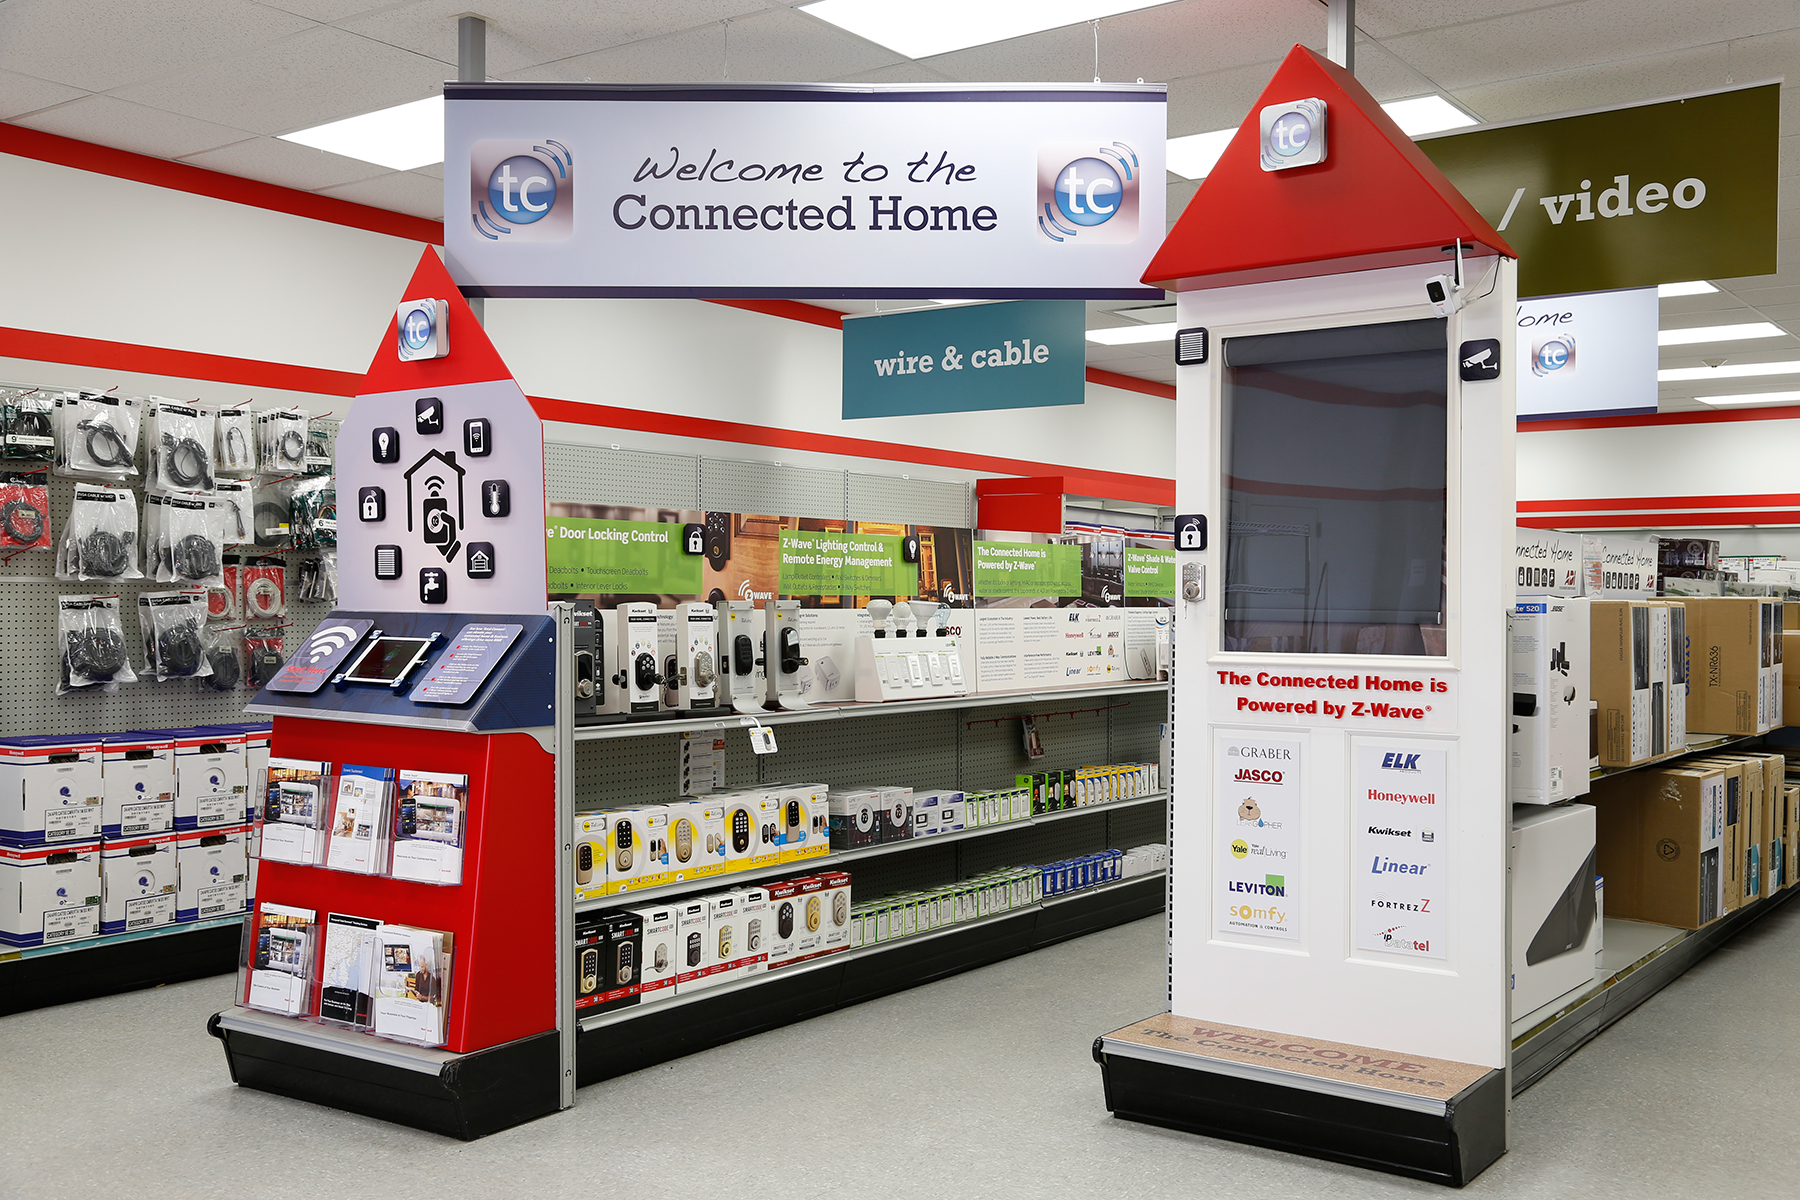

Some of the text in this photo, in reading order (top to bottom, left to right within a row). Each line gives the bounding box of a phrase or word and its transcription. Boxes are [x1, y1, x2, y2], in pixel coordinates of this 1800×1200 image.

[1275, 119, 1306, 151] tc
[632, 147, 978, 185] Welcome to the
[498, 164, 549, 214] tc
[1064, 165, 1115, 216] tc
[1540, 175, 1707, 227] video
[613, 194, 998, 231] Connected Home
[407, 316, 428, 343] tc
[874, 339, 1050, 377] wire & cable
[1542, 345, 1566, 366] tc
[560, 526, 586, 540] Door
[588, 528, 629, 544] Locking
[631, 530, 669, 544] Control
[816, 539, 848, 553] Lighting
[849, 540, 877, 552] Control
[878, 542, 884, 552] &
[977, 546, 990, 556] The
[990, 546, 1023, 558] Connected
[1024, 548, 1040, 558] Home
[1551, 539, 1573, 562] Home
[782, 553, 892, 570] Remote Energy Management
[977, 560, 1004, 570] Powered
[1004, 562, 1012, 572] by
[1636, 548, 1653, 568] Home
[550, 566, 648, 576] Deadbolts Touchscreen Deadbolts
[596, 582, 612, 590] Lever
[1069, 612, 1080, 622] ELK
[285, 665, 326, 674] Start Here
[1708, 646, 1719, 688] TX-NR636
[1217, 670, 1448, 693] The Connected Home is
[1237, 697, 1317, 714] Powered
[1323, 700, 1346, 718] by
[1241, 746, 1292, 760] GRABER
[1382, 752, 1421, 770] ELK
[1368, 789, 1435, 805] Honeywell
[1368, 826, 1412, 838] Kwikset
[1232, 844, 1248, 854] Yale
[1372, 856, 1428, 875] Linear
[802, 882, 822, 890] Kwikset
[829, 878, 848, 886] Kwikset
[1229, 880, 1284, 897] LEVITON
[774, 888, 795, 896] Kwikset
[1230, 905, 1286, 924] somfy
[646, 924, 669, 935] SMARTCODE
[1142, 1028, 1446, 1088] The Connected Home
[1192, 1026, 1427, 1074] WELCOME
